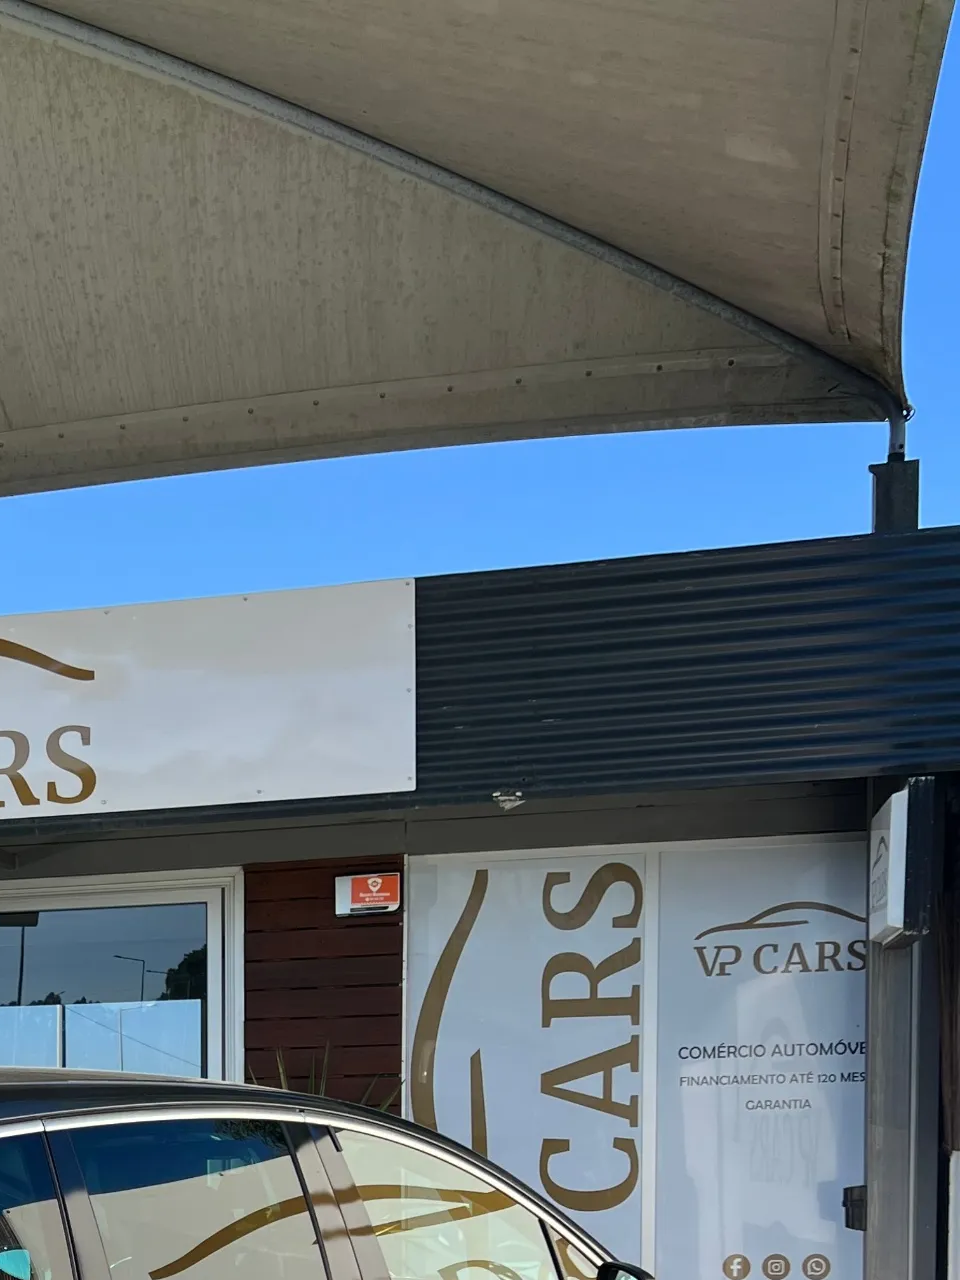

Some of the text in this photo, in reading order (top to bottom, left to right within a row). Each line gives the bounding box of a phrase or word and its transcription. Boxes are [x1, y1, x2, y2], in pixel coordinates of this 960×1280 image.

[693, 940, 867, 977] VP CARS
[539, 862, 644, 1213] CARS
[678, 1042, 767, 1060] COMÉRCIO
[680, 1073, 786, 1088] FINANCIAMENTO
[789, 1071, 814, 1084] ATÉ
[818, 1073, 837, 1084] 120
[745, 1098, 812, 1111] GARANTIA
